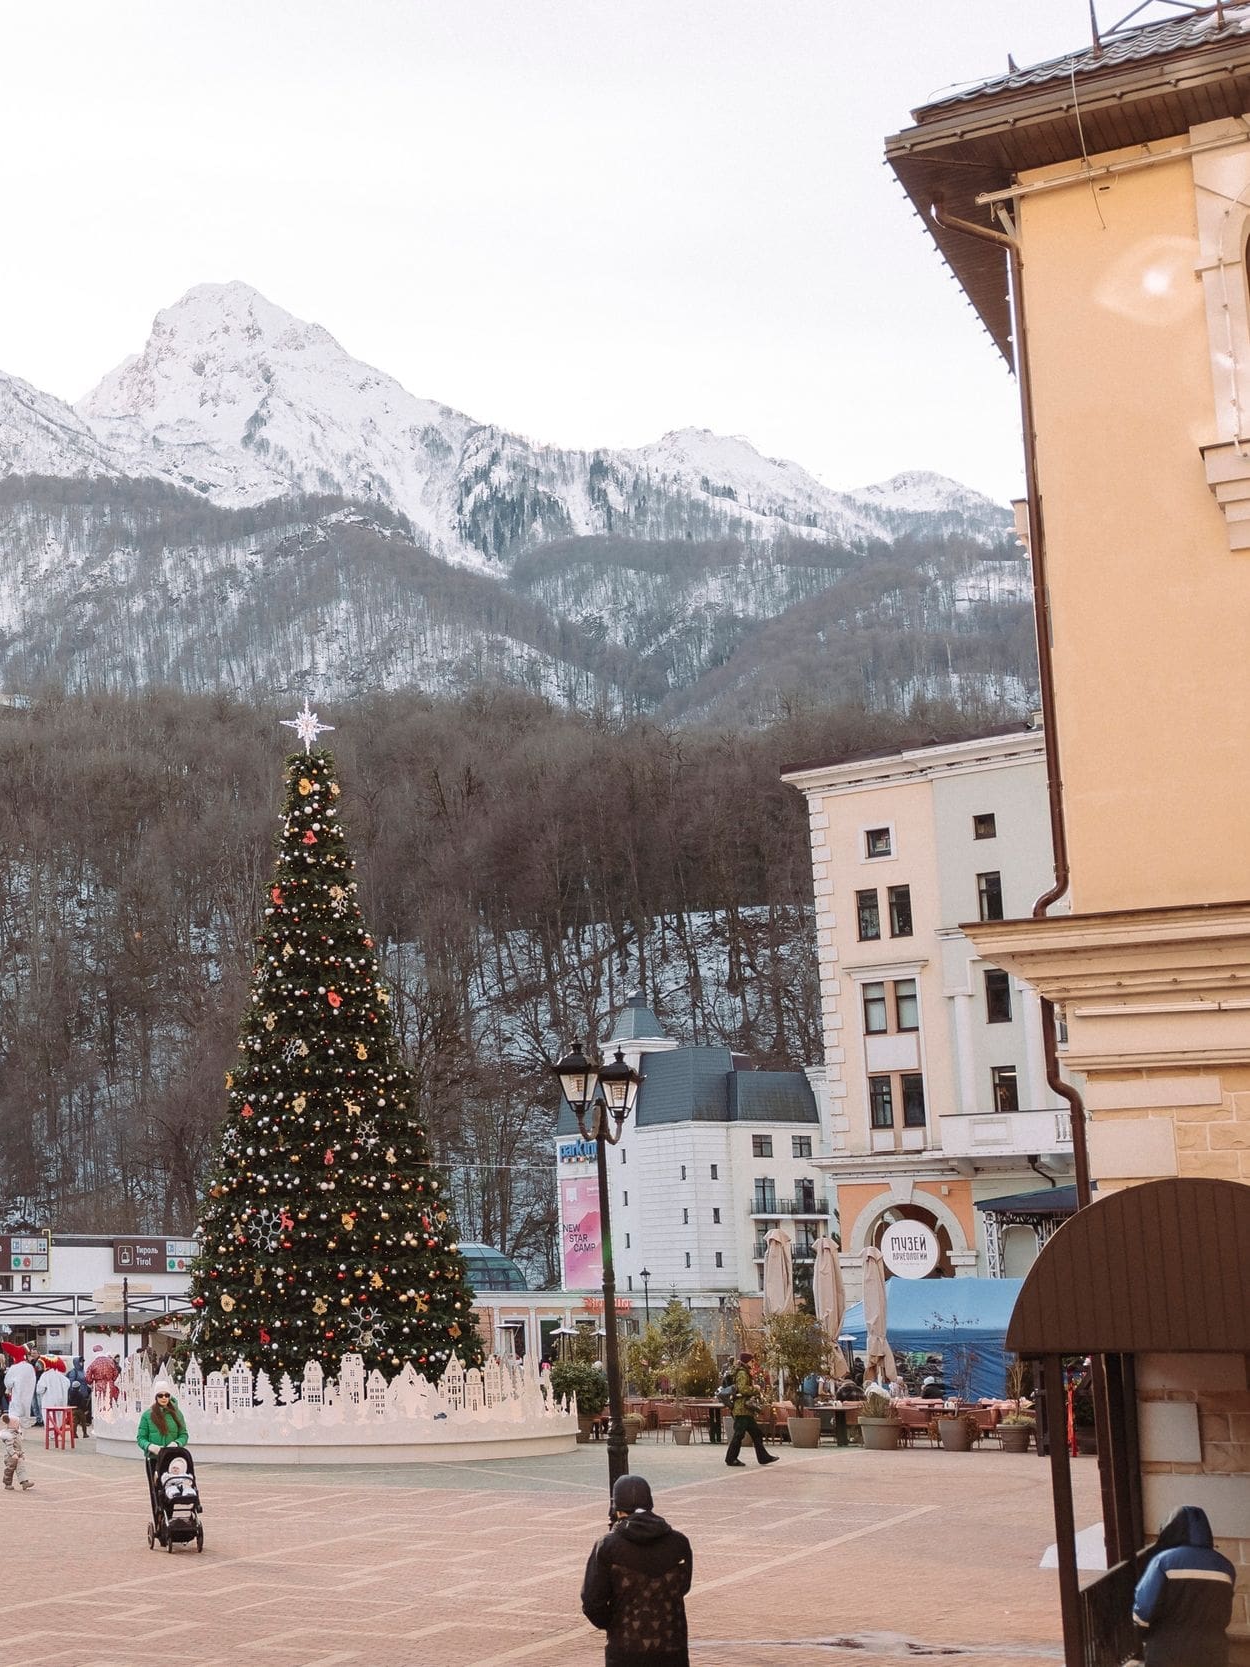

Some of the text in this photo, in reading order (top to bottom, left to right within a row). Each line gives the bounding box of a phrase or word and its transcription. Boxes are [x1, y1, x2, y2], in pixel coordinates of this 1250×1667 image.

[562, 1223, 581, 1233] NEW
[569, 1233, 588, 1243] STAR
[891, 1233, 927, 1251] МУЗЕЙ
[135, 1245, 159, 1255] Тироль
[573, 1243, 596, 1253] CAMP
[136, 1257, 152, 1266] Tirol
